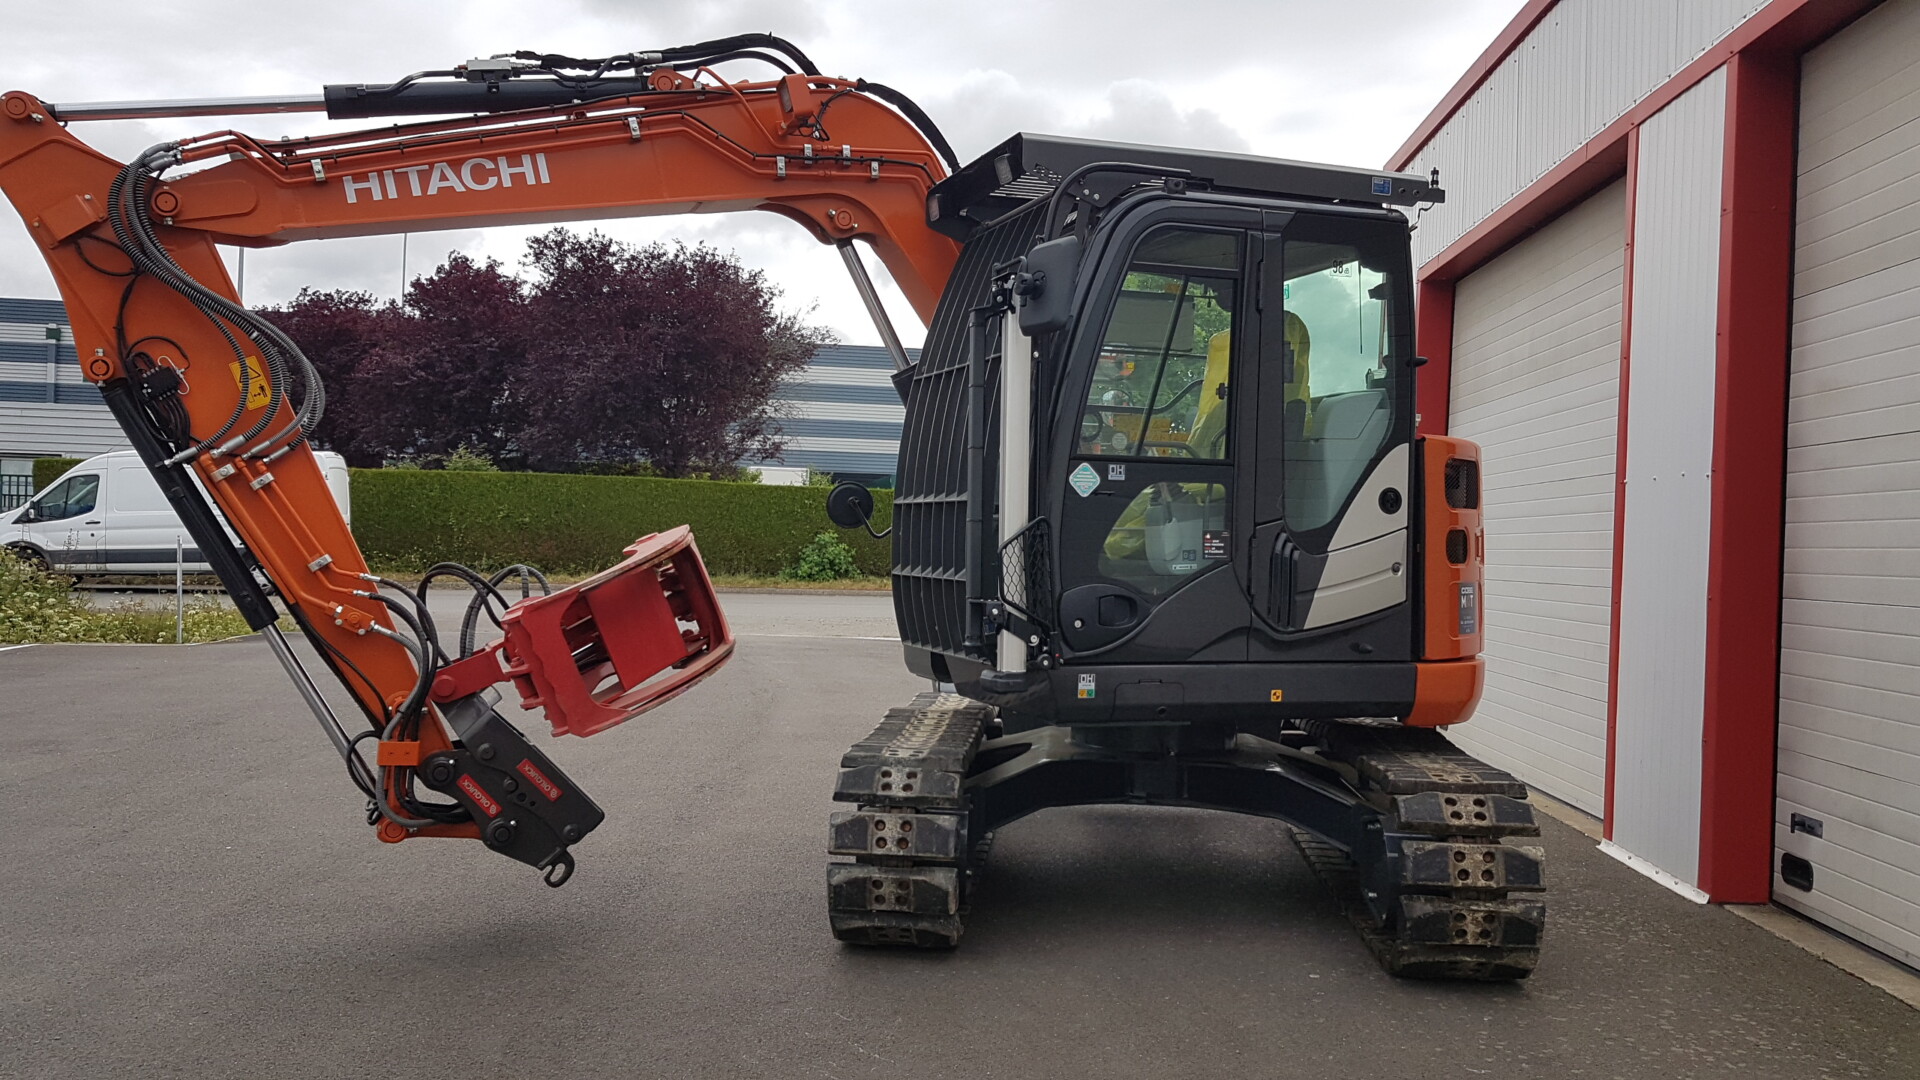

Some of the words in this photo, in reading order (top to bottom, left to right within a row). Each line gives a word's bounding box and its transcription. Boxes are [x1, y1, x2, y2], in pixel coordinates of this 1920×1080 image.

[343, 153, 550, 203] HITACHI
[1332, 260, 1344, 274] 98
[523, 765, 551, 792] OILQUICK
[462, 779, 491, 808] OILQUICK
